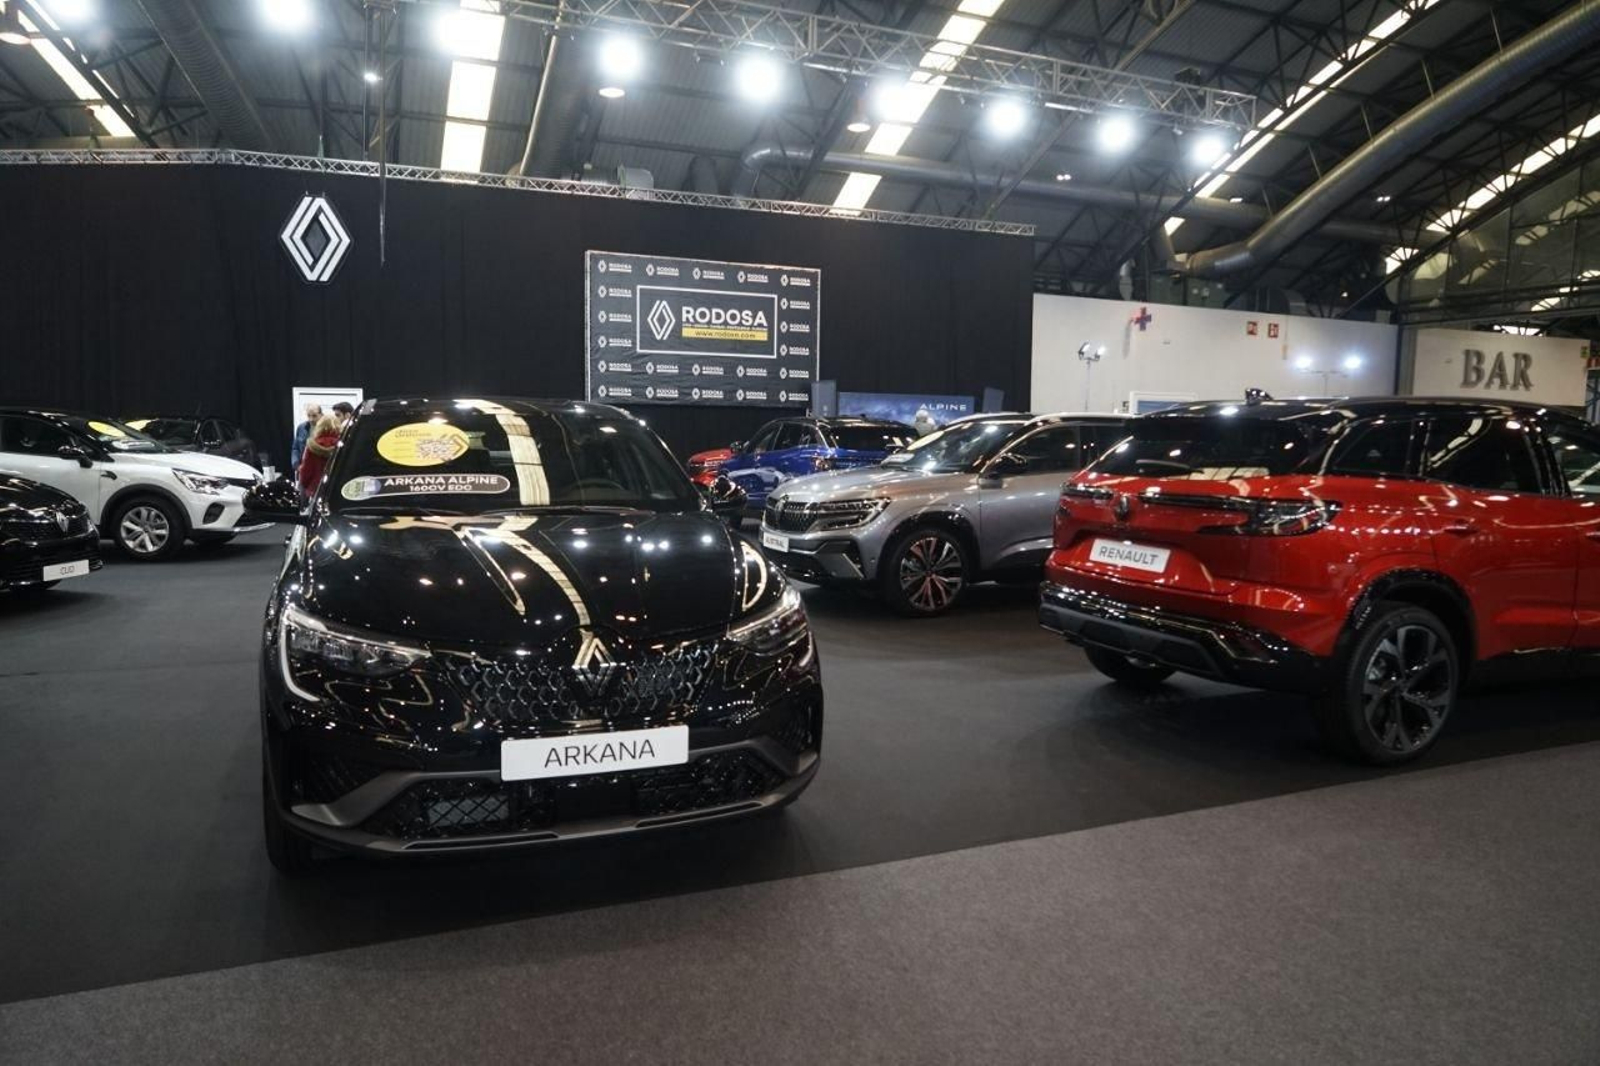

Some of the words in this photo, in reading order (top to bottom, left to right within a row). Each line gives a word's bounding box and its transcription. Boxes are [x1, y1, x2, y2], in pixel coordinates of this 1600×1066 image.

[682, 306, 768, 327] RODOSA
[1460, 349, 1535, 391] BAR
[920, 403, 967, 411] ALPINE
[384, 476, 446, 486] ARKANA
[448, 475, 498, 485] ALPINE
[1099, 545, 1159, 566] RENAULT
[544, 739, 655, 768] ARKANA
